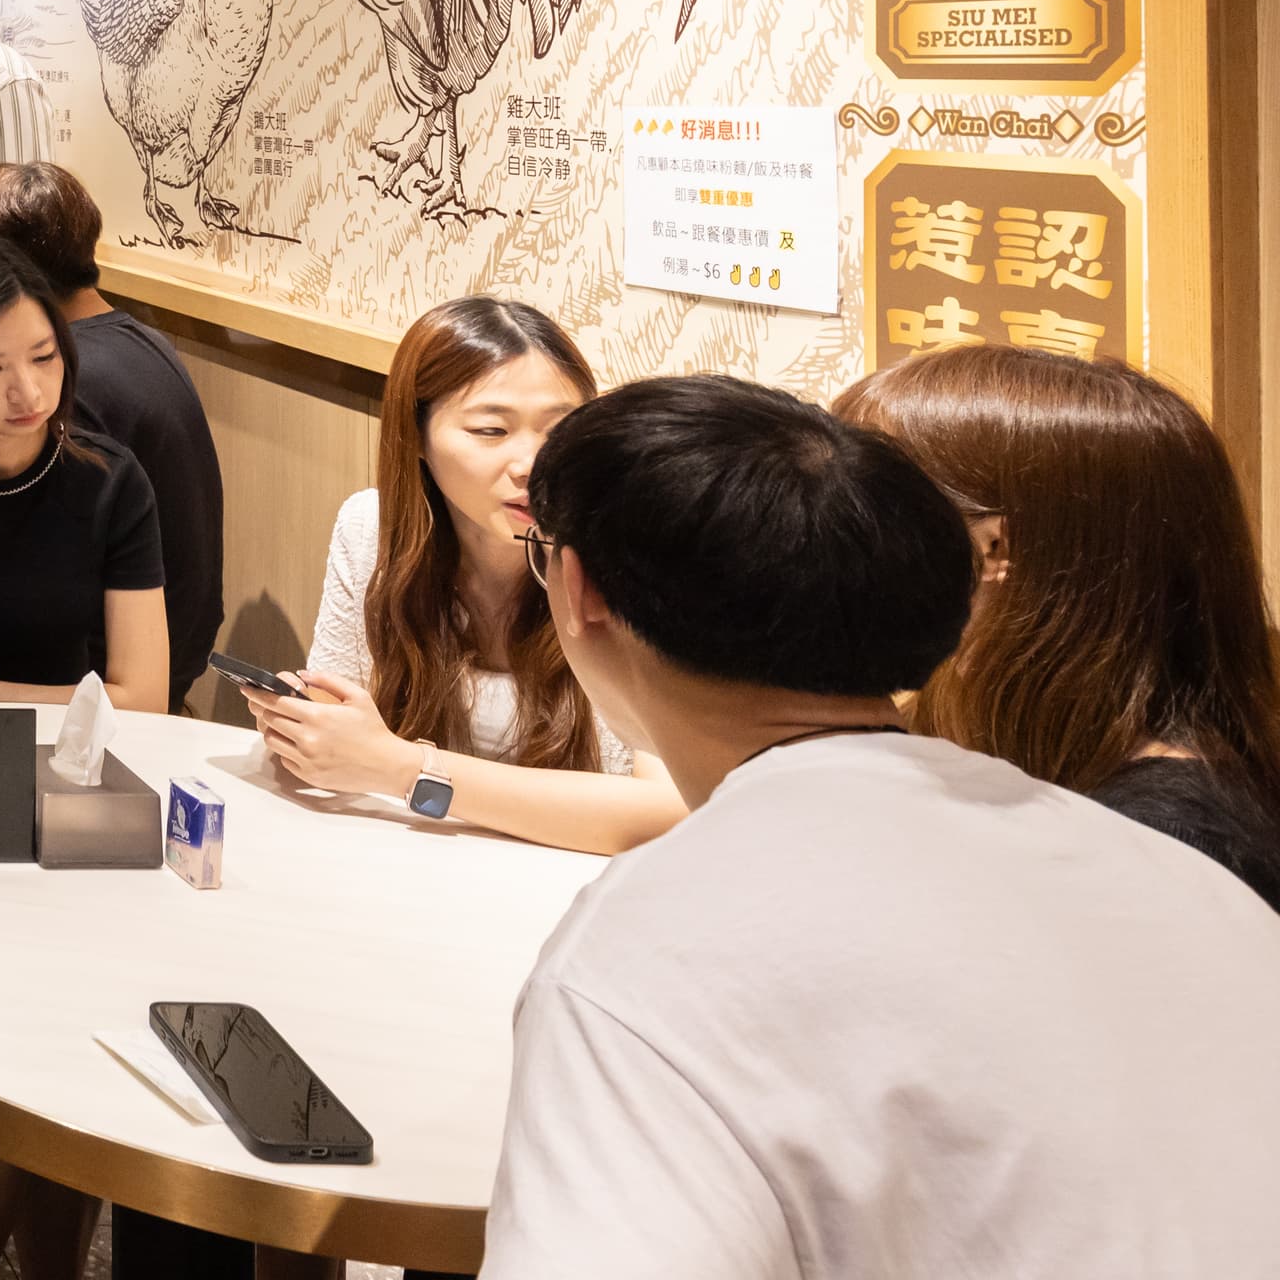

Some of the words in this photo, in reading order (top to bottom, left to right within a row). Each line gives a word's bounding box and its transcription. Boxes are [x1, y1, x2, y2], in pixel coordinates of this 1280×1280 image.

[947, 9, 986, 27] SIU
[992, 7, 1037, 26] MEI
[916, 28, 1073, 49] SPECIALISED
[506, 94, 561, 121] 雞大班
[680, 118, 761, 141] 好消息!!!
[935, 110, 989, 136] Wan
[991, 111, 1053, 139] Chai
[674, 186, 754, 208] 即享雙重優惠
[779, 229, 796, 251] 及
